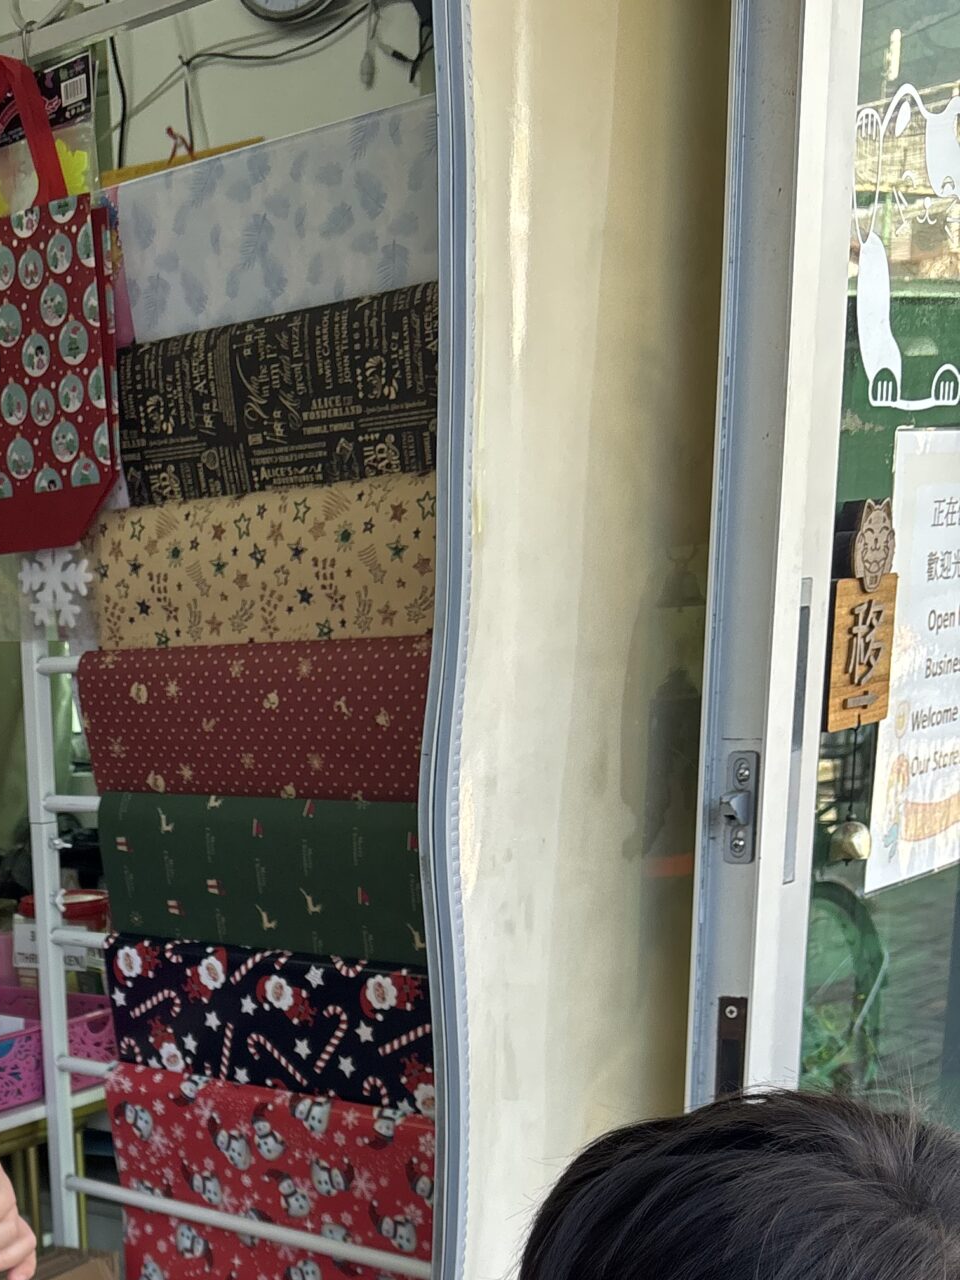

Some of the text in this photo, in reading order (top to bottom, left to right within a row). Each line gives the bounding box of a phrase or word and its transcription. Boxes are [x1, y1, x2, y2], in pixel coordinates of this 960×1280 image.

[931, 497, 960, 527] 正在
[928, 609, 956, 635] Open
[848, 600, 884, 685] 移
[925, 653, 960, 679] Busine
[911, 705, 959, 732] Welcome
[911, 756, 930, 777] Our
